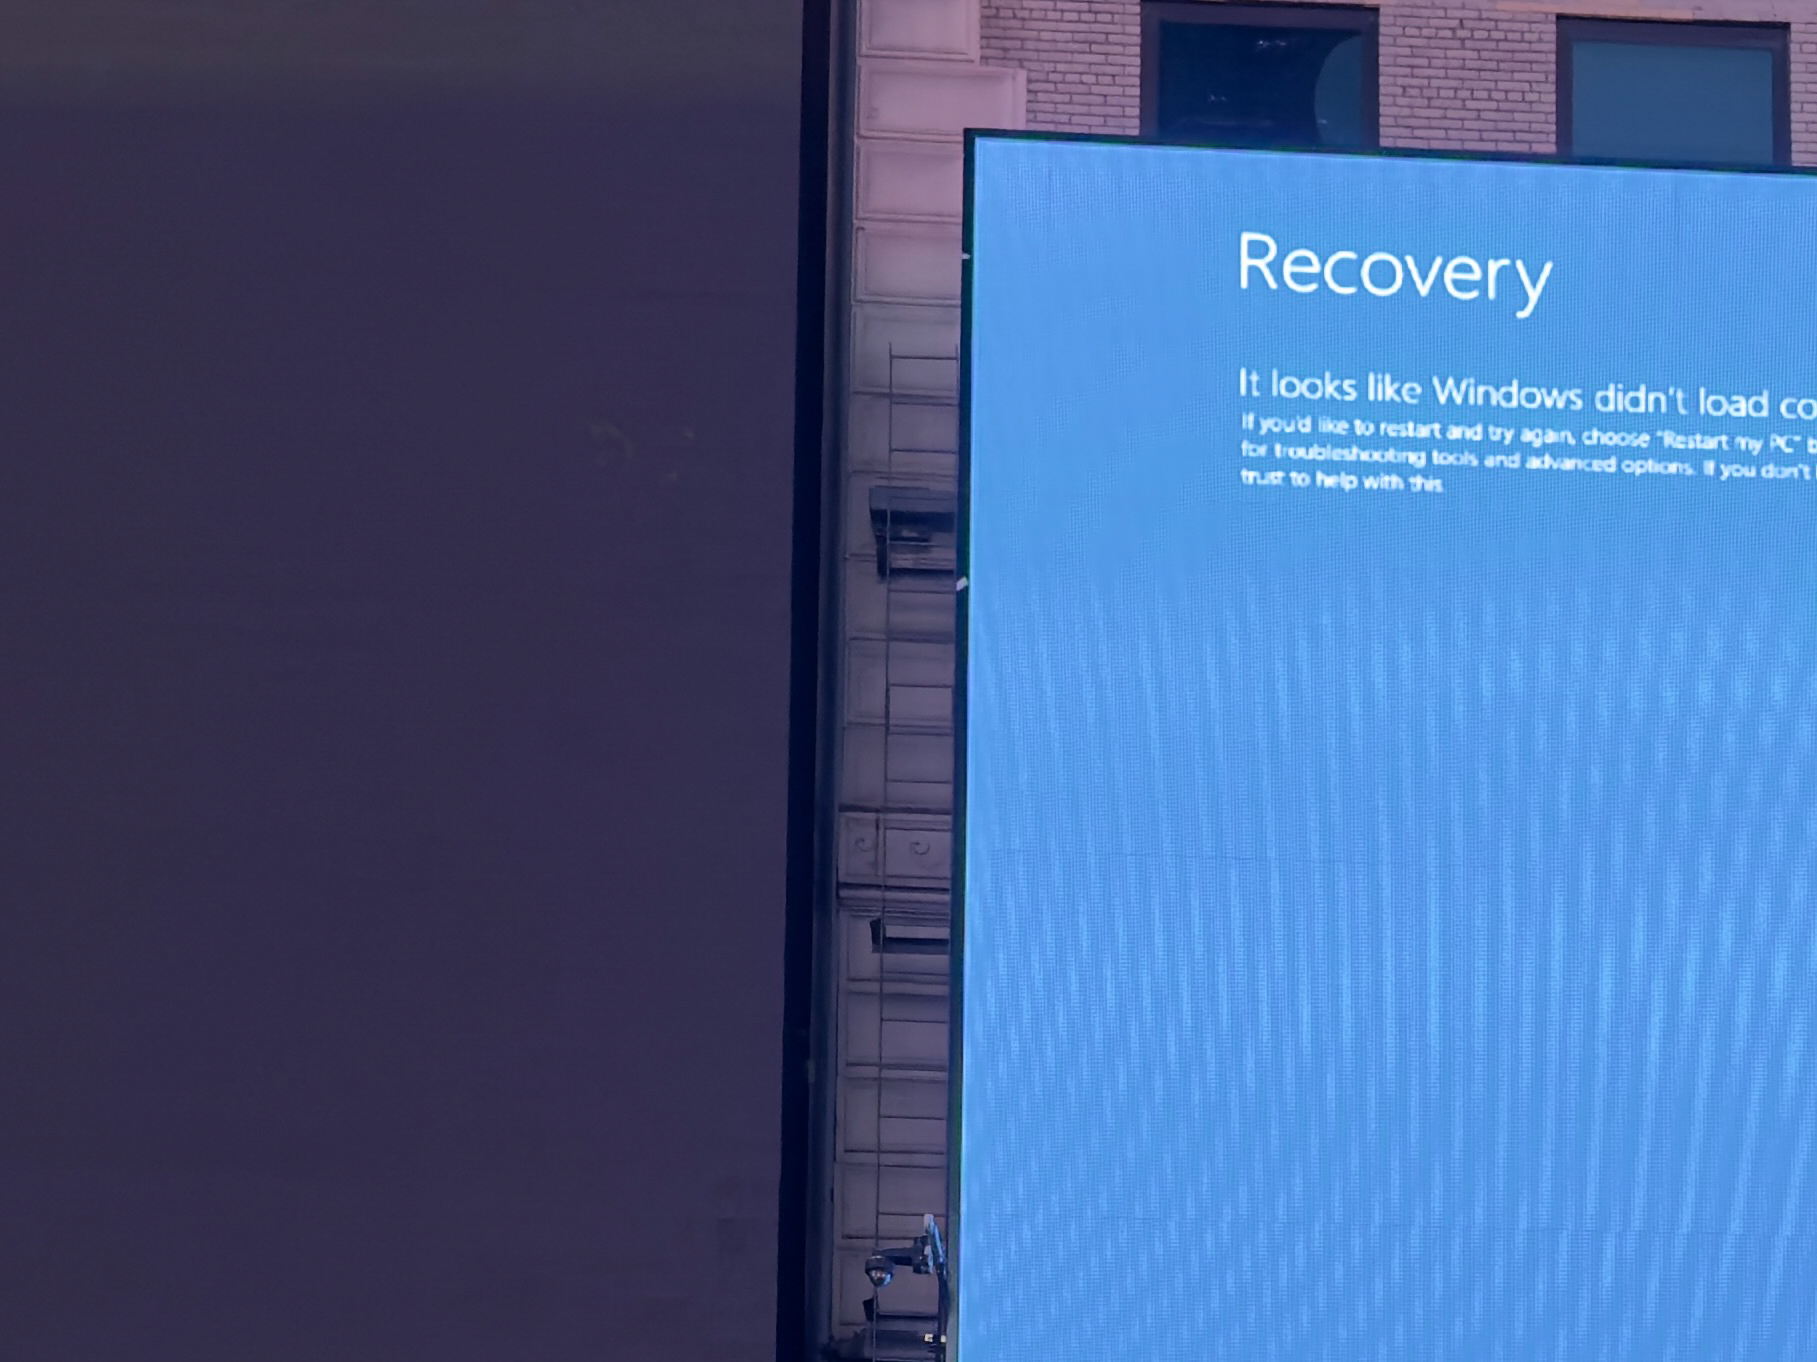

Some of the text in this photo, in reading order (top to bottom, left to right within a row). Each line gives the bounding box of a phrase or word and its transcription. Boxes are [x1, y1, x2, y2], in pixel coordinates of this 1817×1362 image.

[1239, 231, 1553, 318] Recovery
[1239, 368, 1261, 398] It
[1271, 367, 1358, 402] looks
[1368, 371, 1422, 404] like
[1432, 374, 1583, 411] Windows
[1594, 382, 1689, 414] didn't
[1698, 387, 1770, 418] load
[1241, 412, 1255, 431] If
[1259, 414, 1312, 435] you'd
[1318, 415, 1350, 434] like
[1353, 419, 1375, 436] to
[1379, 420, 1442, 440] restart
[1446, 422, 1484, 441] and
[1488, 425, 1515, 446] try
[1581, 429, 1651, 447] choose
[1734, 436, 1765, 456] my
[1240, 440, 1267, 458] for
[1274, 441, 1428, 468] troubleshooting
[1431, 449, 1479, 467] tools
[1483, 451, 1521, 469] and
[1525, 452, 1617, 472] advanced
[1703, 460, 1716, 475] If
[1720, 463, 1757, 481] you
[1760, 463, 1812, 480] don't
[1240, 468, 1285, 486] trust
[1289, 470, 1311, 487] to
[1316, 471, 1359, 492] help
[1362, 473, 1405, 491] with
